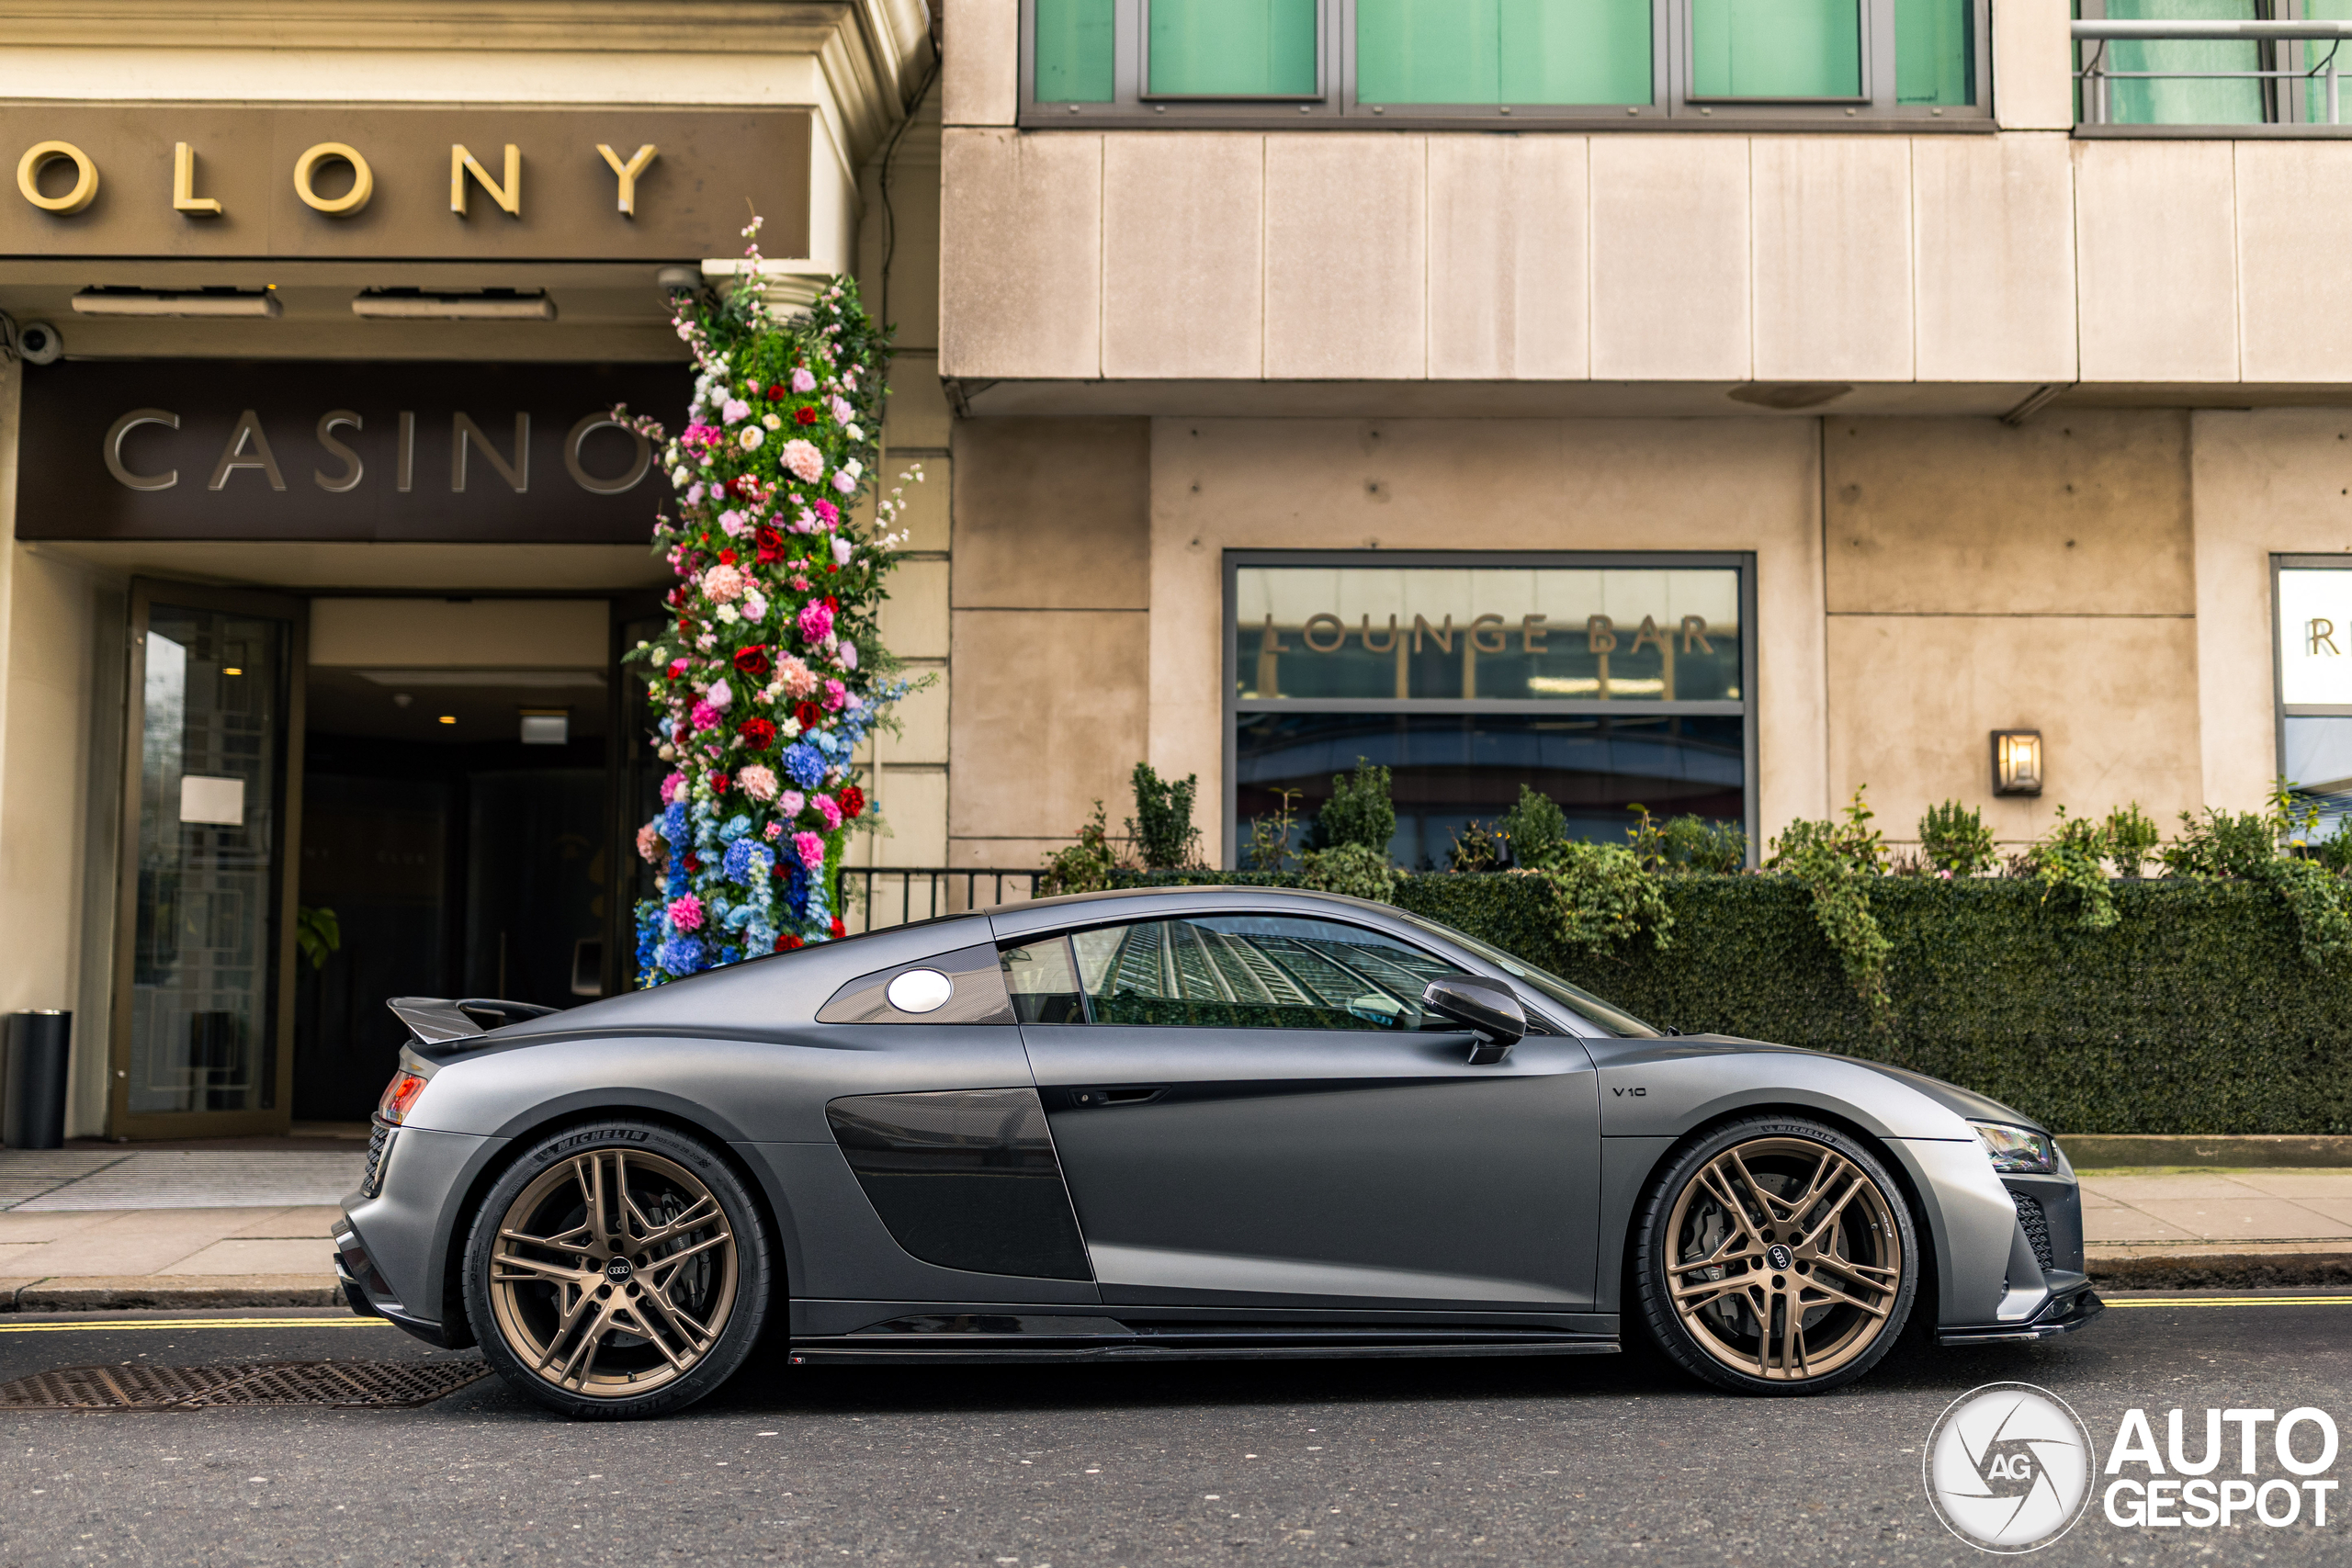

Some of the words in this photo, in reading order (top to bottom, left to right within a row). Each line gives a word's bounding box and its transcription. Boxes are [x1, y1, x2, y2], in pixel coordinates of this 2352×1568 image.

[17, 141, 659, 217] OLONY
[103, 408, 651, 494] CASINO
[1264, 613, 1549, 654] LOUNGE
[1587, 614, 1714, 655] BAR
[558, 1130, 644, 1151] MICHELIN
[654, 1135, 679, 1148] 305/30
[1777, 1125, 1833, 1142] MICHELIN
